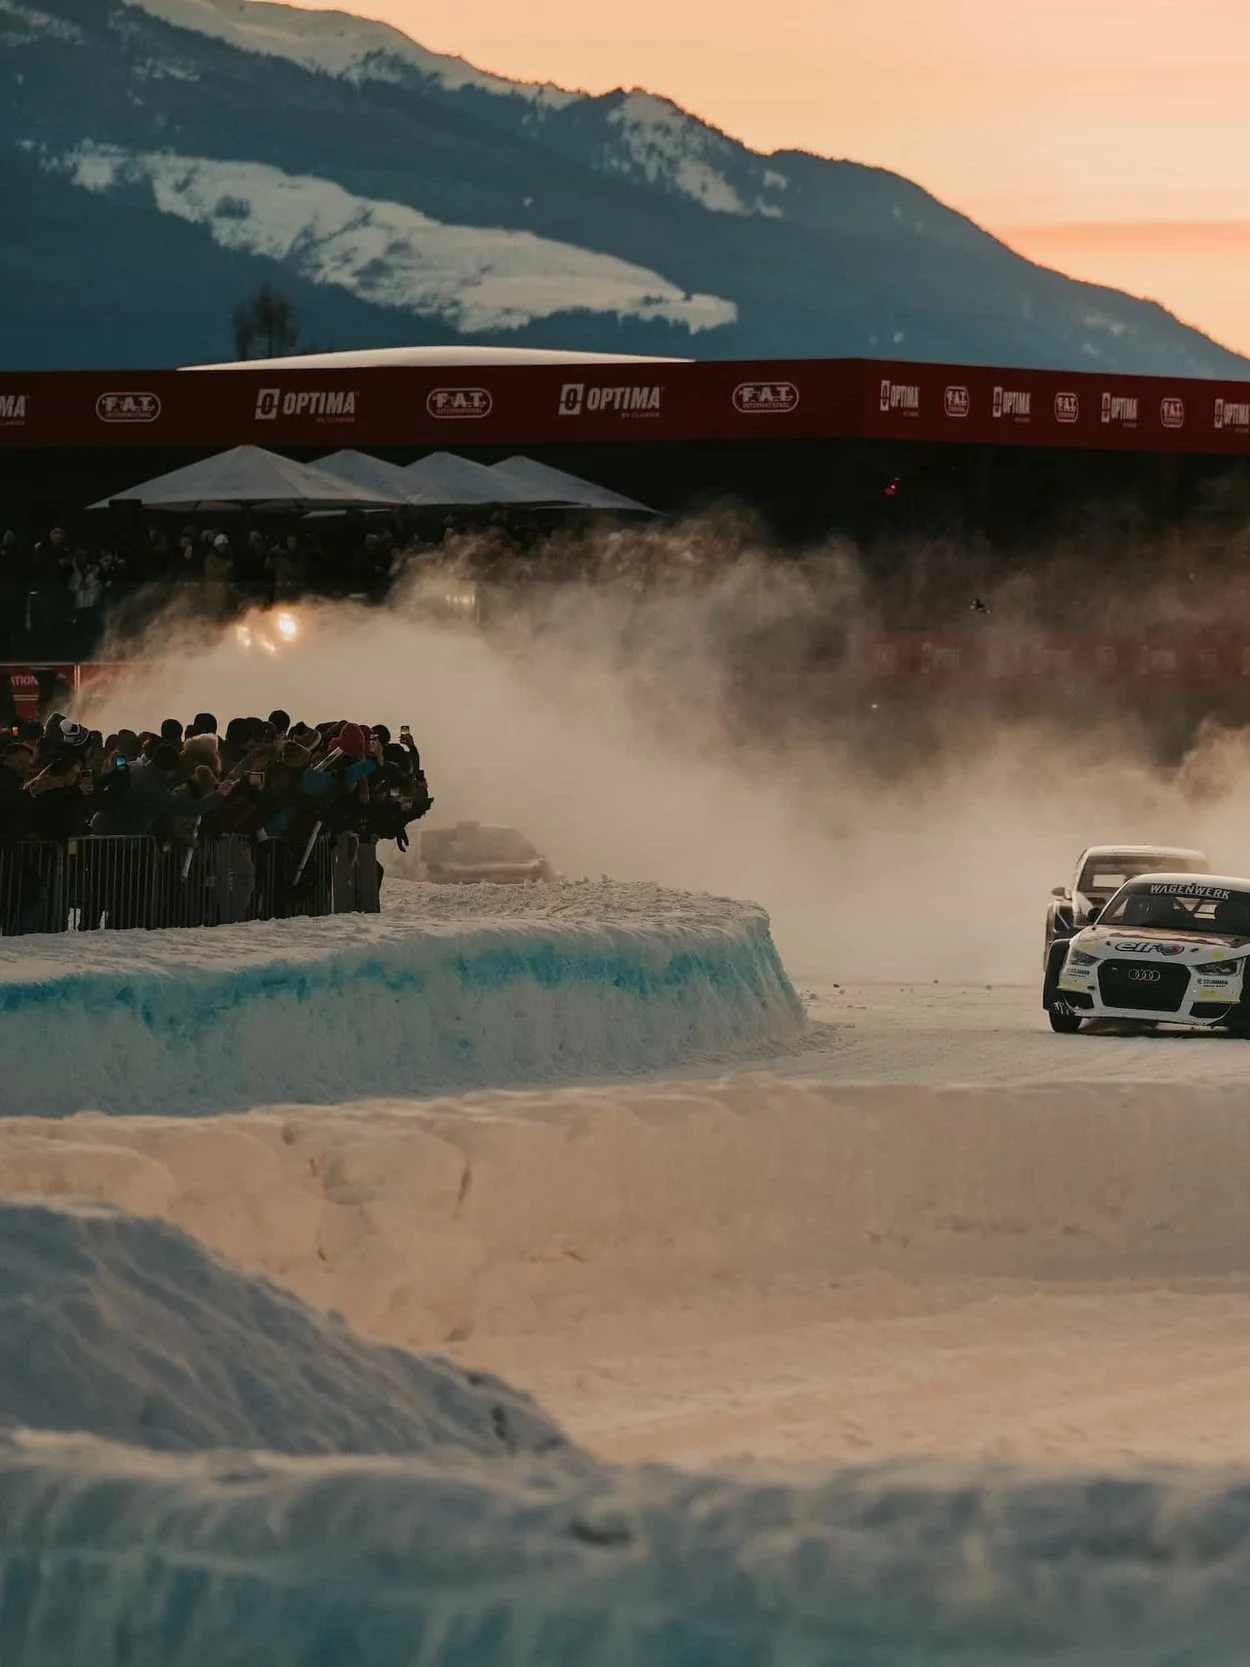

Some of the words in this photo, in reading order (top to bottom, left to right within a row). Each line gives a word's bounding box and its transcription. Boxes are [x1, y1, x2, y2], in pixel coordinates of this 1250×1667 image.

[283, 391, 355, 415] OPTIMA
[587, 386, 660, 411] OPTIMA
[890, 386, 919, 408] OPTIMA
[1150, 884, 1231, 900] WAGENWERK
